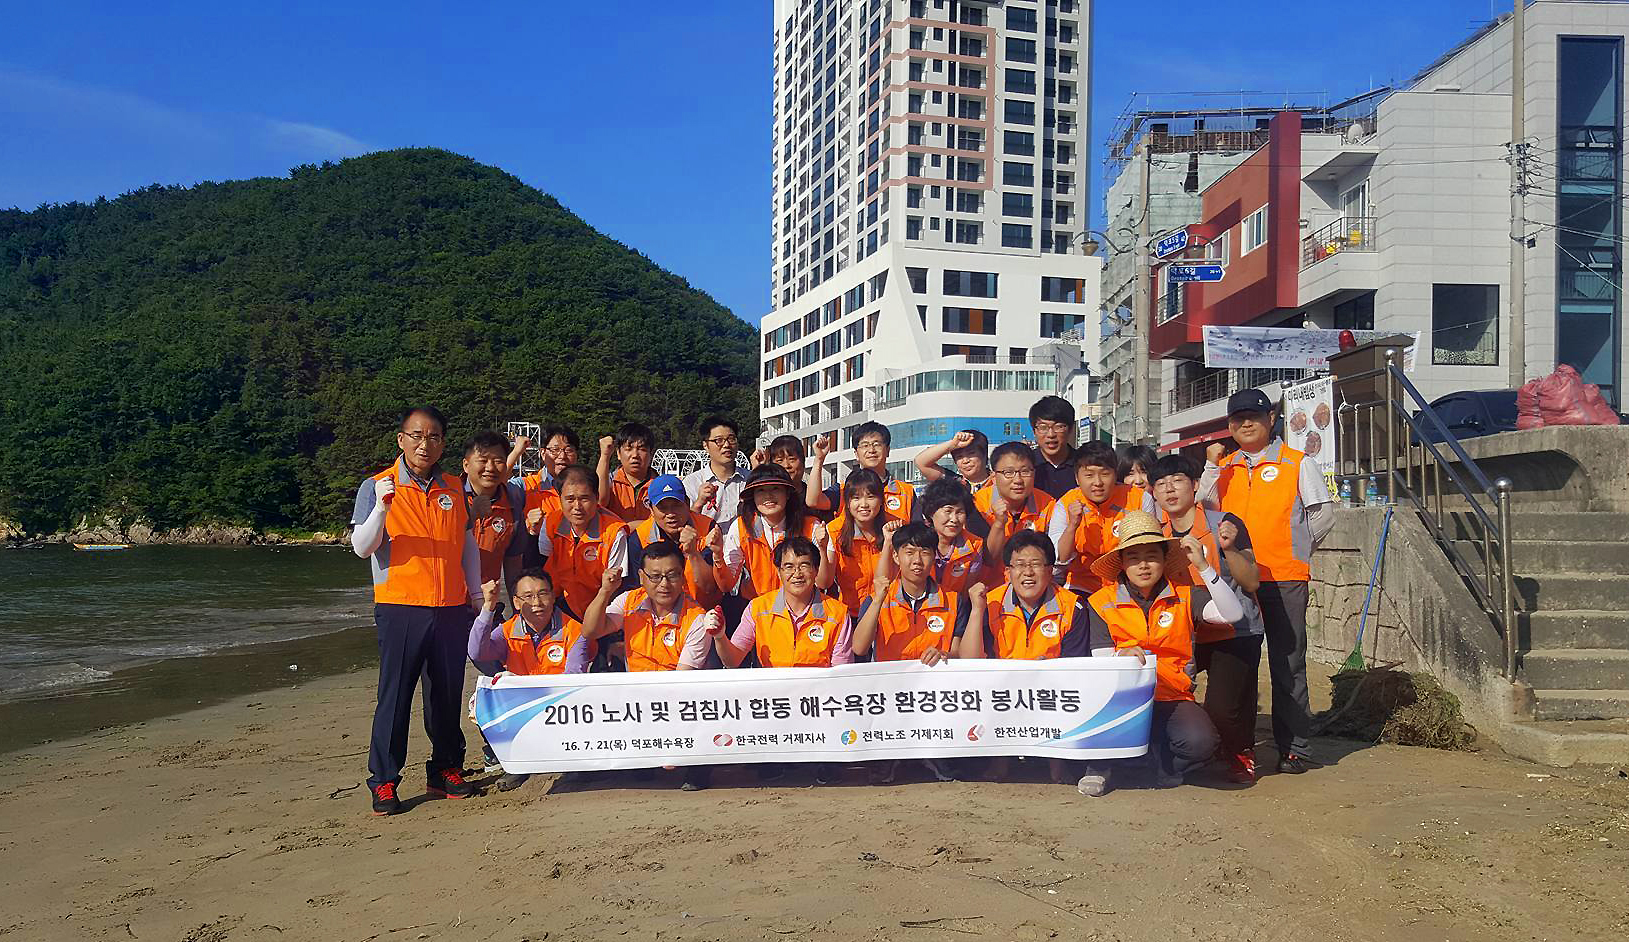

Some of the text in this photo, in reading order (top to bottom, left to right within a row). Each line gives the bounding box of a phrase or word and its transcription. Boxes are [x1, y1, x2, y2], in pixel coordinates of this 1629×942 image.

[544, 688, 1081, 726] 2016 노사 및 검침사 합동 해수욕장 환경정화 봉사활동
[735, 732, 826, 746] 한국전력 거제지사
[862, 728, 954, 743] 전력노조 거제지회
[993, 726, 1062, 740] 한전산업개발
[583, 740, 593, 750] 7.
[631, 737, 695, 750] 덕포해수욕장
